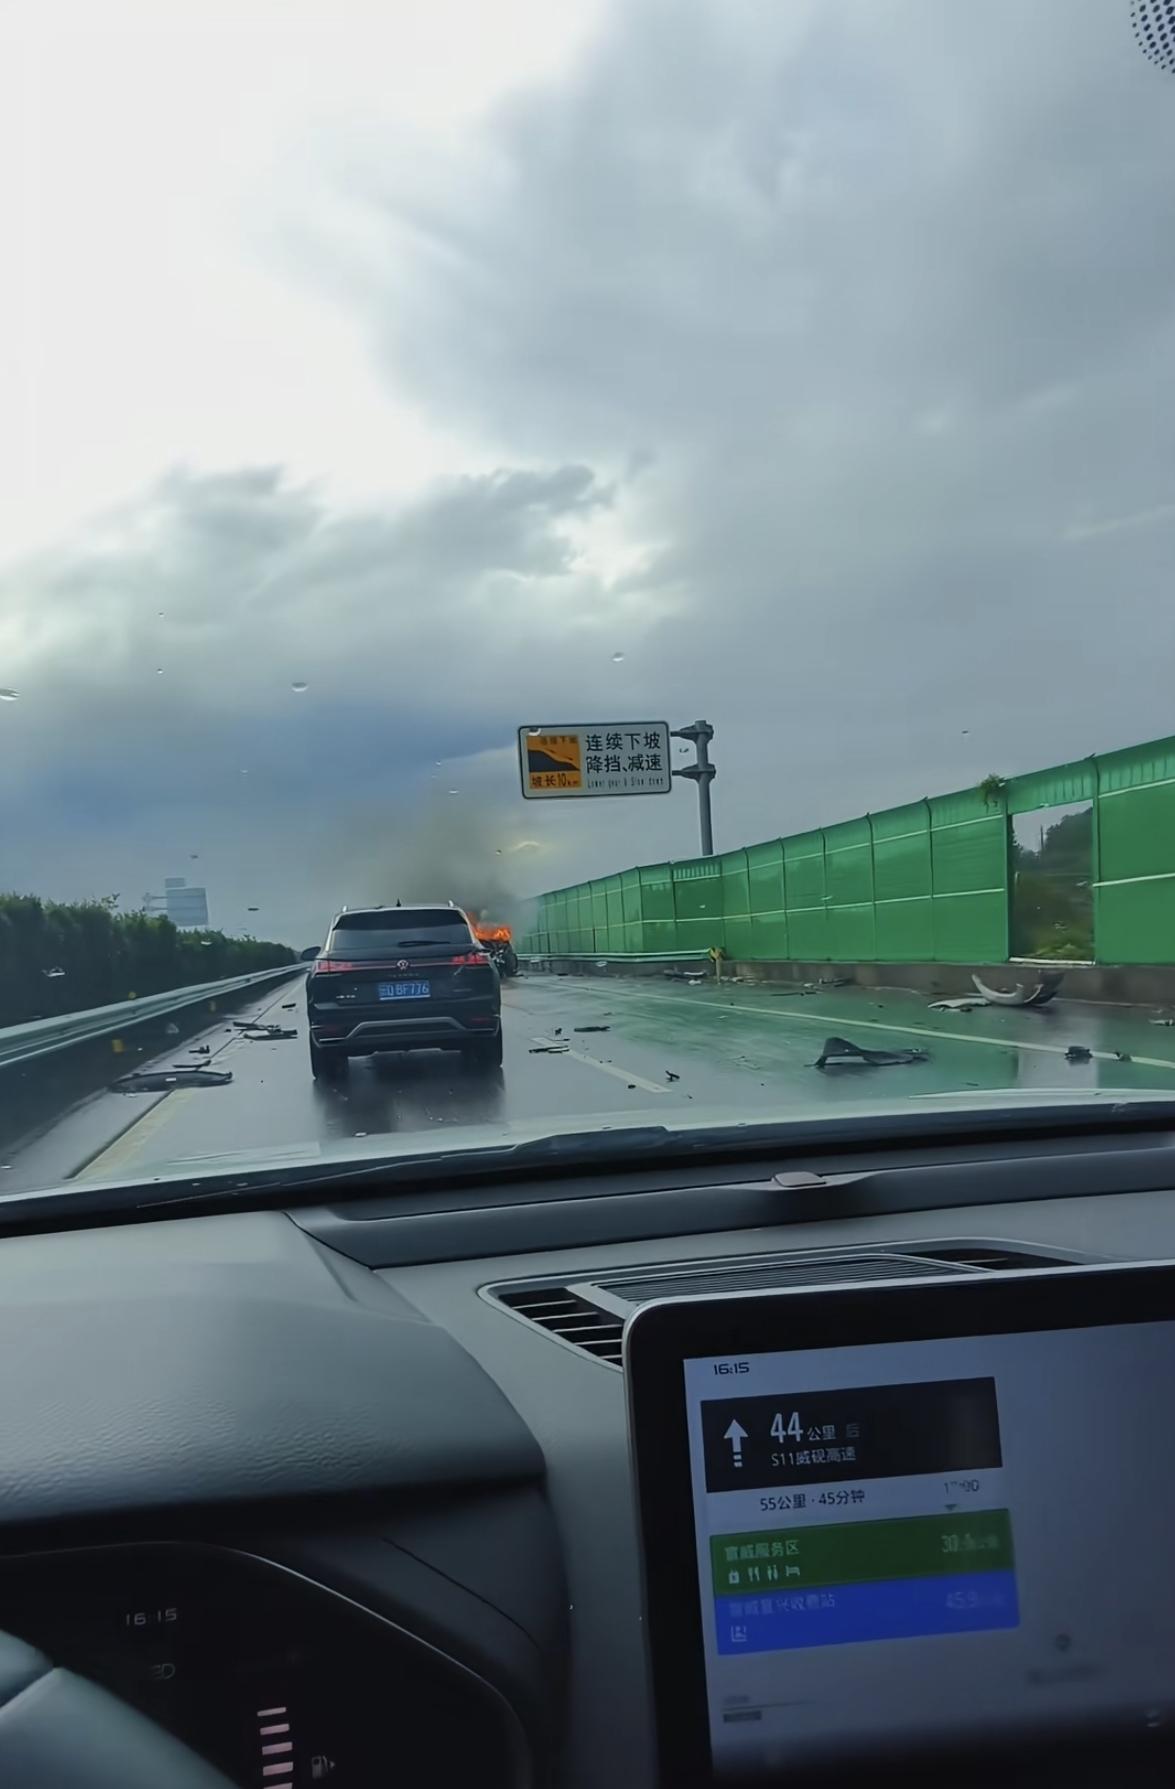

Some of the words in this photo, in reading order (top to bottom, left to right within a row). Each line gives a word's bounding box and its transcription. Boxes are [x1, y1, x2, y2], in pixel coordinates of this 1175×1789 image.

[586, 732, 661, 752] 连续下坡
[586, 754, 663, 773] 降挡、减速
[713, 1362, 750, 1375] 16:15
